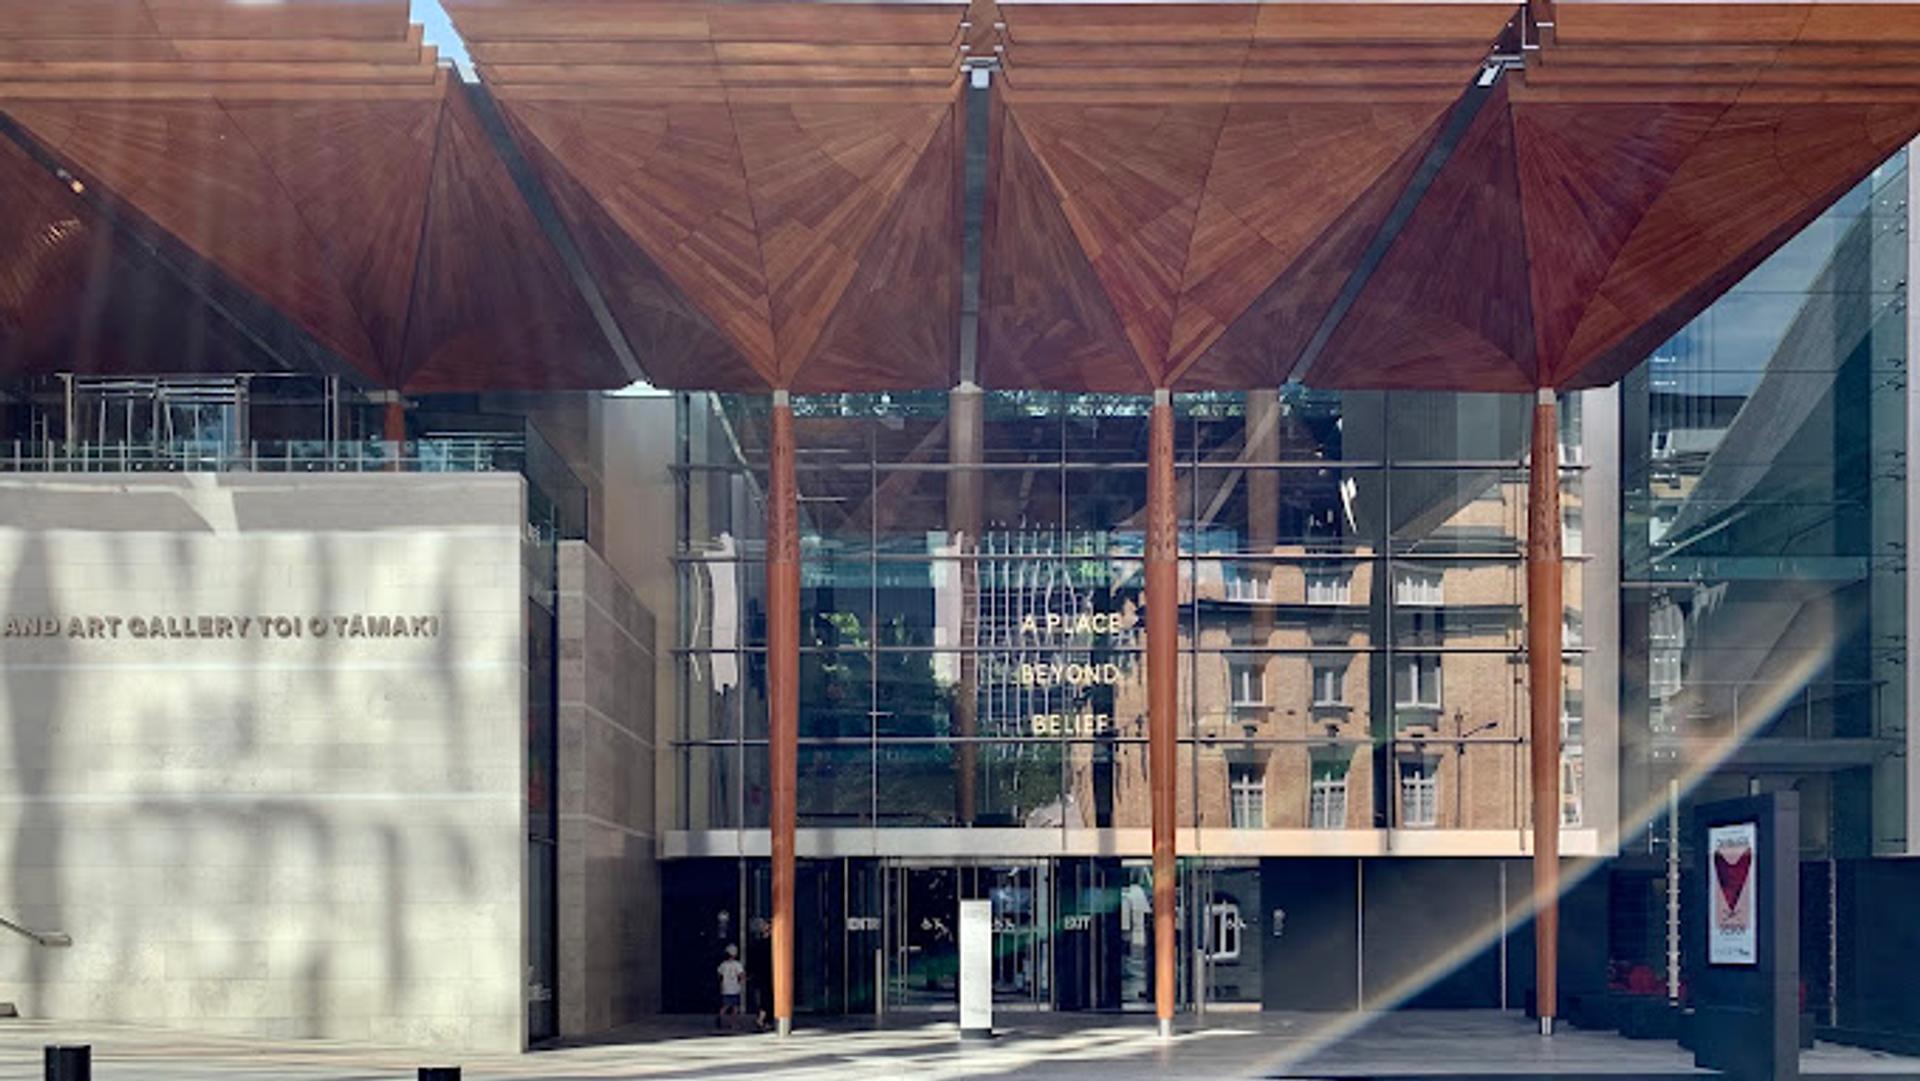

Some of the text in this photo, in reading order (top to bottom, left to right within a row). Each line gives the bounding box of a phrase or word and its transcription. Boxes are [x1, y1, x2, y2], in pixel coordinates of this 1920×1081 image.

[4, 616, 61, 637] AND
[68, 616, 122, 638] ART
[127, 616, 251, 638] GALLERY
[257, 616, 302, 638] TOI
[308, 616, 328, 638] O
[1020, 613, 1121, 634] A PLACE
[1021, 663, 1120, 684] BEYOND
[1032, 714, 1108, 735] BELIEF
[1064, 915, 1091, 930] EXIT
